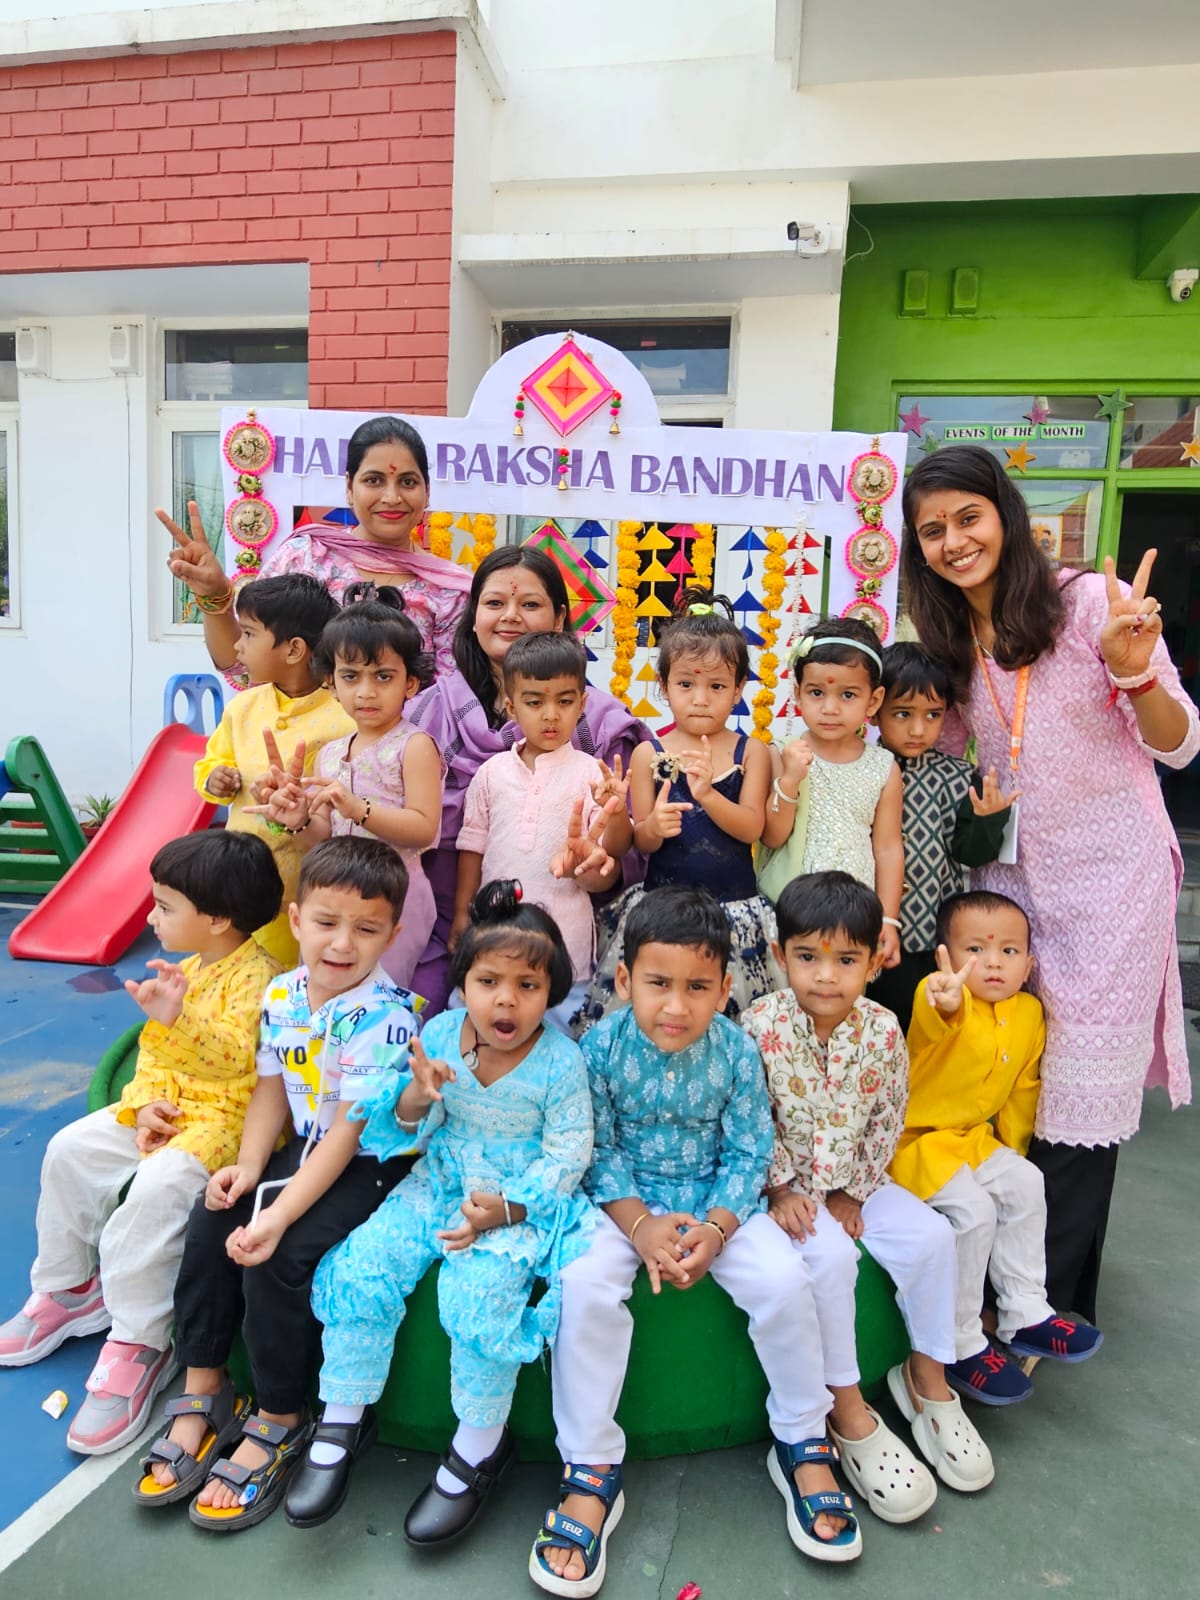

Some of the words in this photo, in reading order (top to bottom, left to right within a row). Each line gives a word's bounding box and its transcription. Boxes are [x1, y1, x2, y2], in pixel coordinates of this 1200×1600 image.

[946, 427, 986, 439] EVENTS
[994, 427, 1008, 437] OF
[1013, 427, 1032, 437] THE
[1043, 426, 1083, 437] MONTH
[436, 443, 615, 490] RAKSHA
[630, 454, 846, 503] BANDHAN
[561, 1521, 583, 1536] TEUZ
